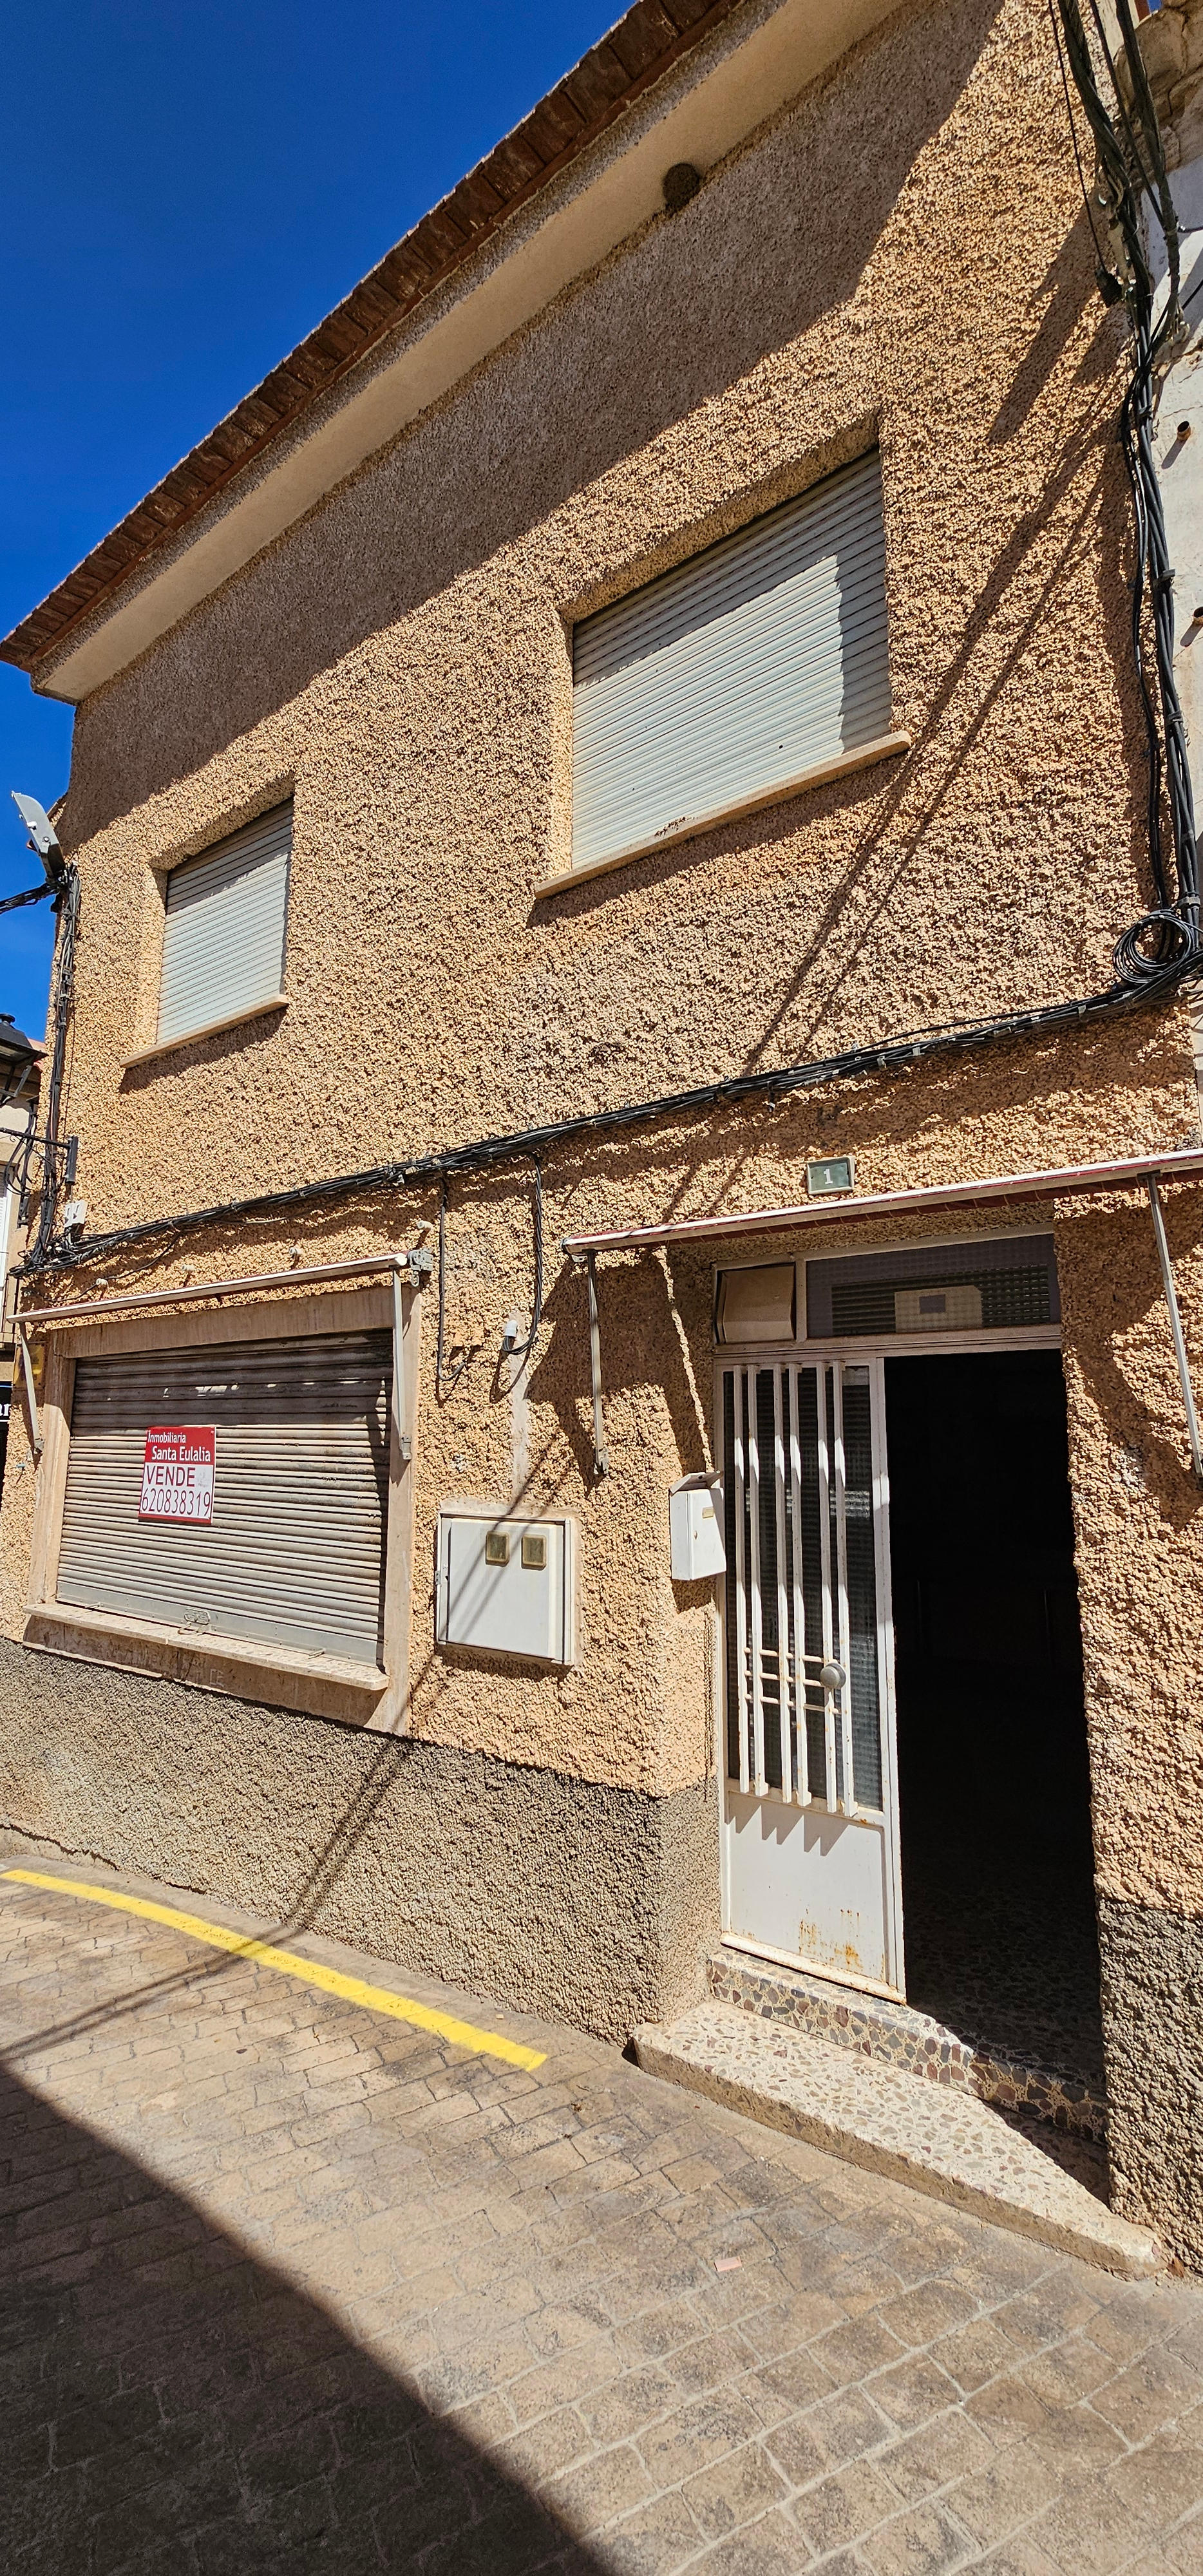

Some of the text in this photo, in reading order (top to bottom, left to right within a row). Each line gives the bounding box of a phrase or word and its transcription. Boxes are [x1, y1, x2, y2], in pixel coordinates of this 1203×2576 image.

[824, 1169, 833, 1184] 1
[147, 1432, 186, 1443] Inmobiliaria
[151, 1446, 211, 1462] Santa Eulalia
[147, 1466, 195, 1487] VENDE
[142, 1488, 211, 1516] 620838319
